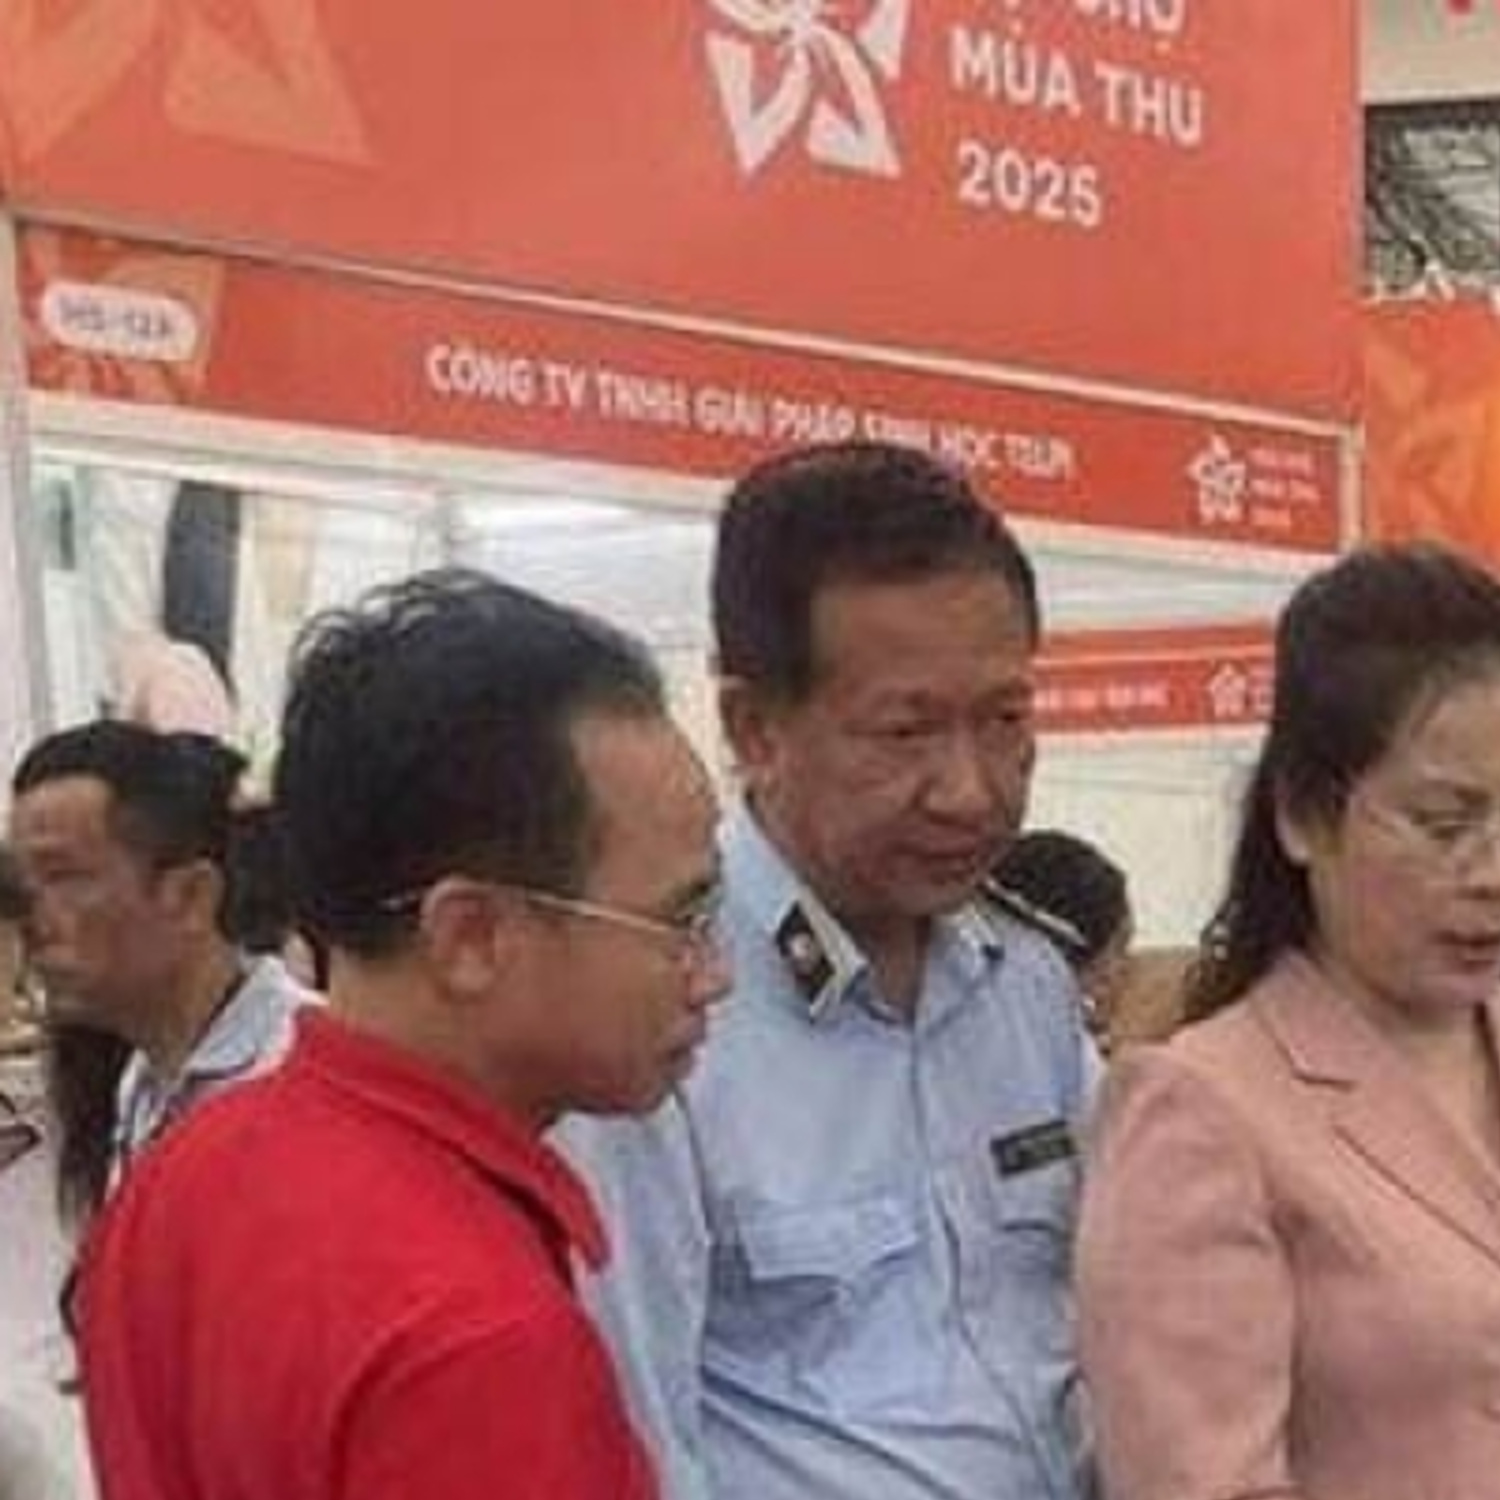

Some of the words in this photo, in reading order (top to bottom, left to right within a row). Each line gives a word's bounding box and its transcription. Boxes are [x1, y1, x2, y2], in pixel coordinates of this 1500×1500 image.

[951, 18, 1082, 118] MÙA
[1094, 58, 1203, 147] THU
[957, 137, 1101, 228] 2025
